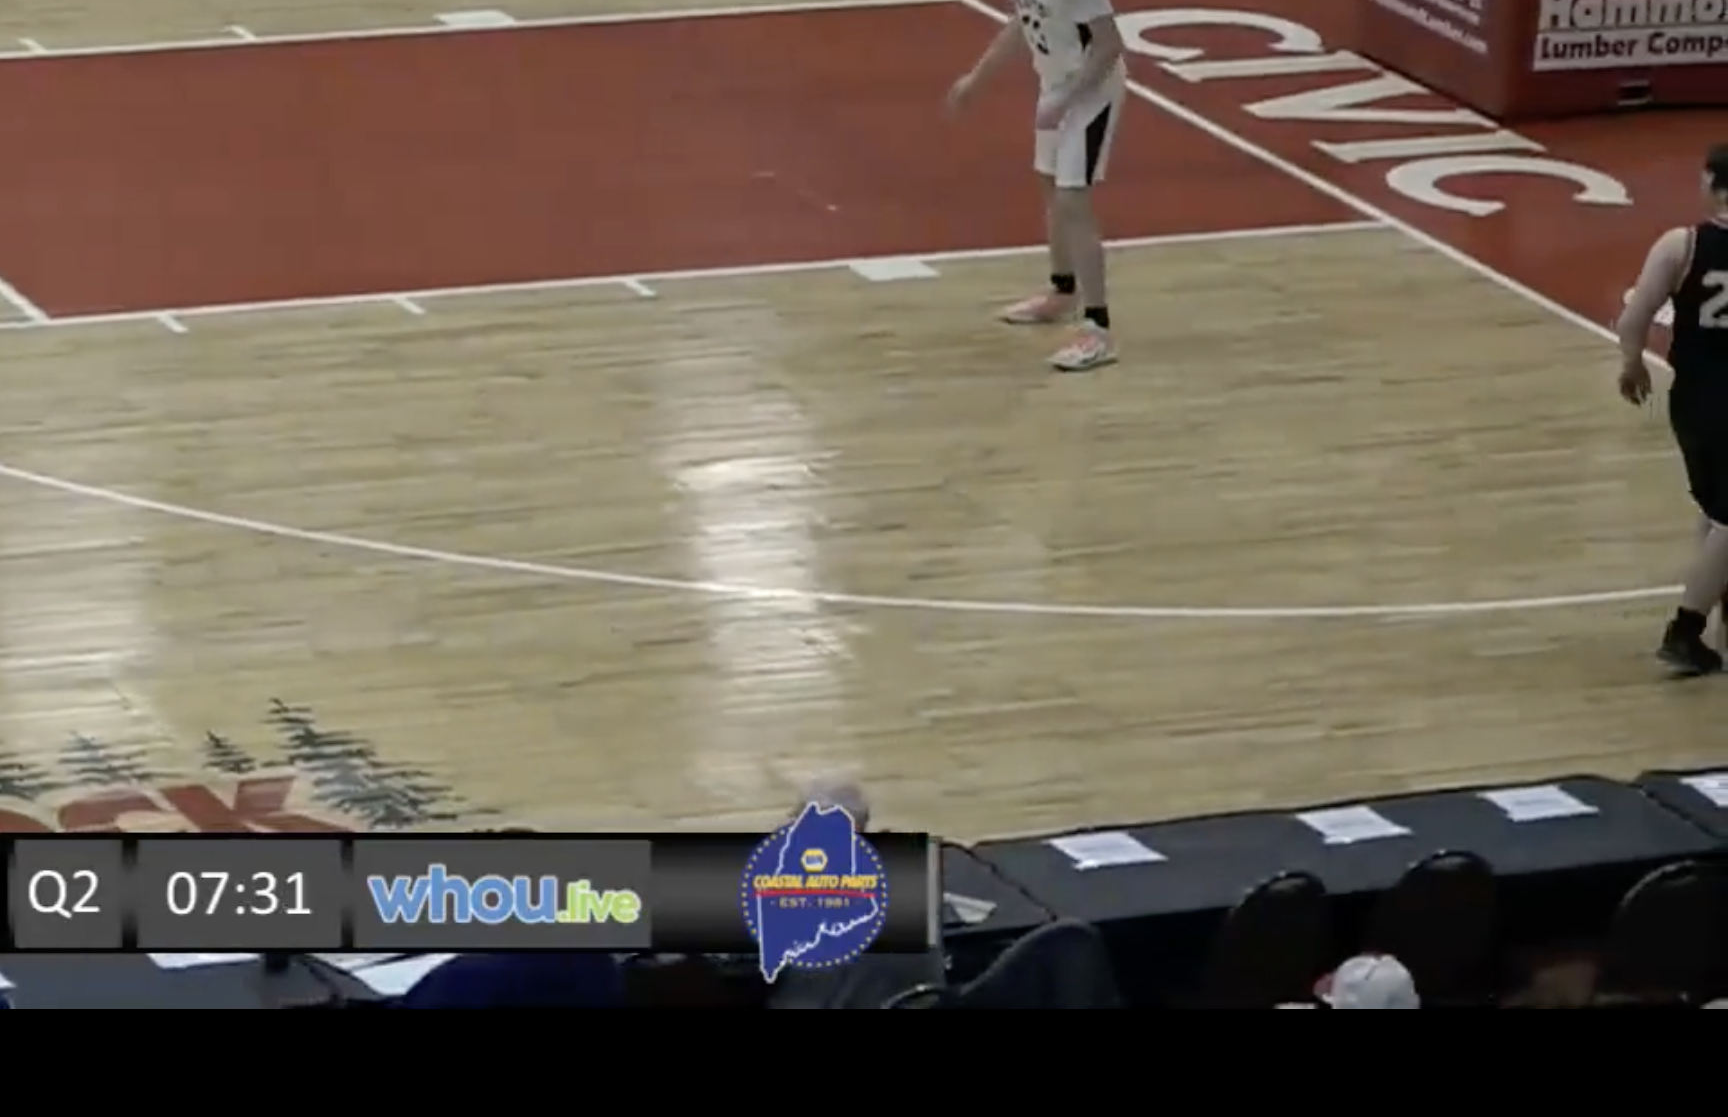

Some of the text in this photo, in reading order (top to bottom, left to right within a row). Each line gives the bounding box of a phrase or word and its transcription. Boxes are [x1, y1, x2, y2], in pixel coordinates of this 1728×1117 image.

[1542, 32, 1728, 60] Lumber Comp
[1115, 8, 1634, 216] CIVIC
